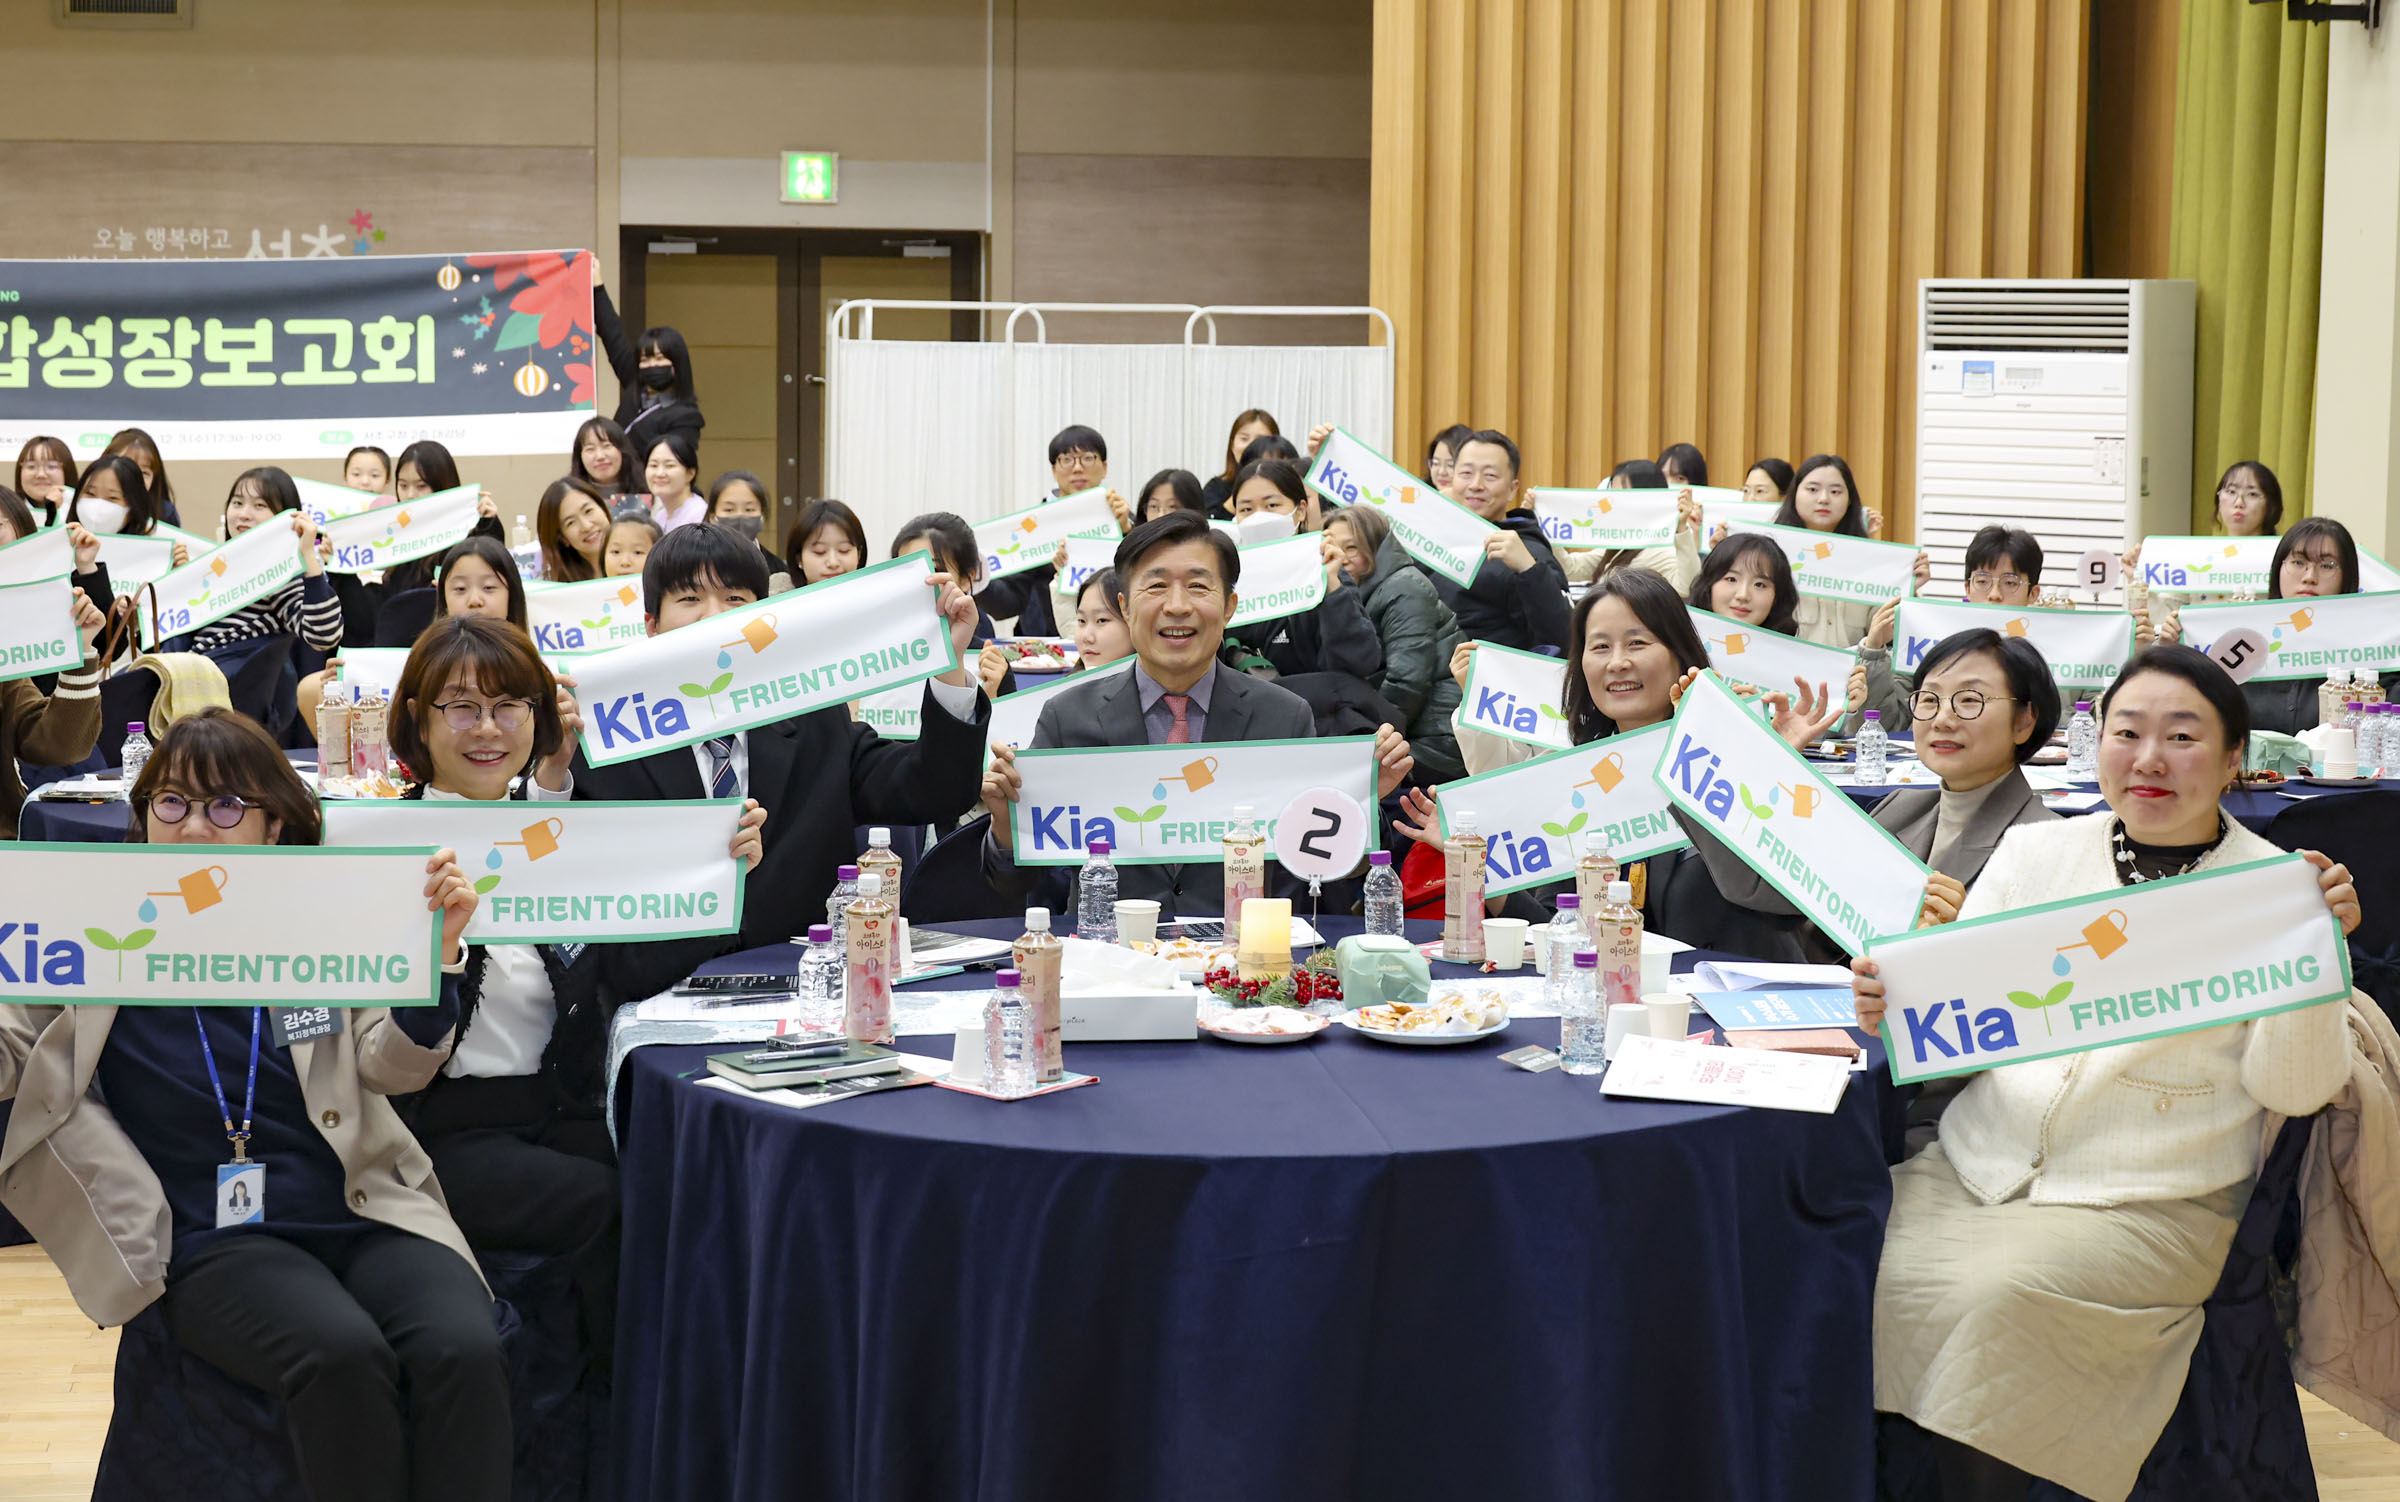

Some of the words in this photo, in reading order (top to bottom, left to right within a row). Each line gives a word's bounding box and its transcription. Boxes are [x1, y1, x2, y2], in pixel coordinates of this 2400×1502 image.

[94, 227, 137, 251] 오늘
[145, 226, 232, 251] 행복하고
[1319, 459, 1359, 504] Kia
[301, 502, 327, 526] ia
[1539, 516, 1573, 540] Kia
[337, 544, 374, 569] Kia
[1797, 572, 1902, 598] FRIENTORING
[2089, 561, 2106, 584] 9
[2144, 562, 2187, 586] Kia
[533, 622, 585, 652] Kia
[2219, 638, 2255, 670] 5
[2278, 644, 2400, 668] FRIENTORIN
[593, 691, 691, 750] Kia
[729, 638, 930, 714] FRIENTORING
[858, 707, 922, 727] FRIENT
[1475, 686, 1538, 735] Kia
[1031, 804, 1116, 851] Kia
[1298, 807, 1341, 860] 2
[1668, 732, 1736, 824] Kia
[1756, 826, 1884, 941] FRIENTORIN
[1485, 829, 1553, 884] Kia
[491, 891, 719, 923] FRIENTORING
[145, 952, 411, 984] FRIENTORING
[282, 1006, 331, 1031] 김수경
[1903, 997, 2020, 1063] Kia
[2069, 954, 2321, 1031] FRIENTORING
[287, 1023, 332, 1041] 복지정책과장
